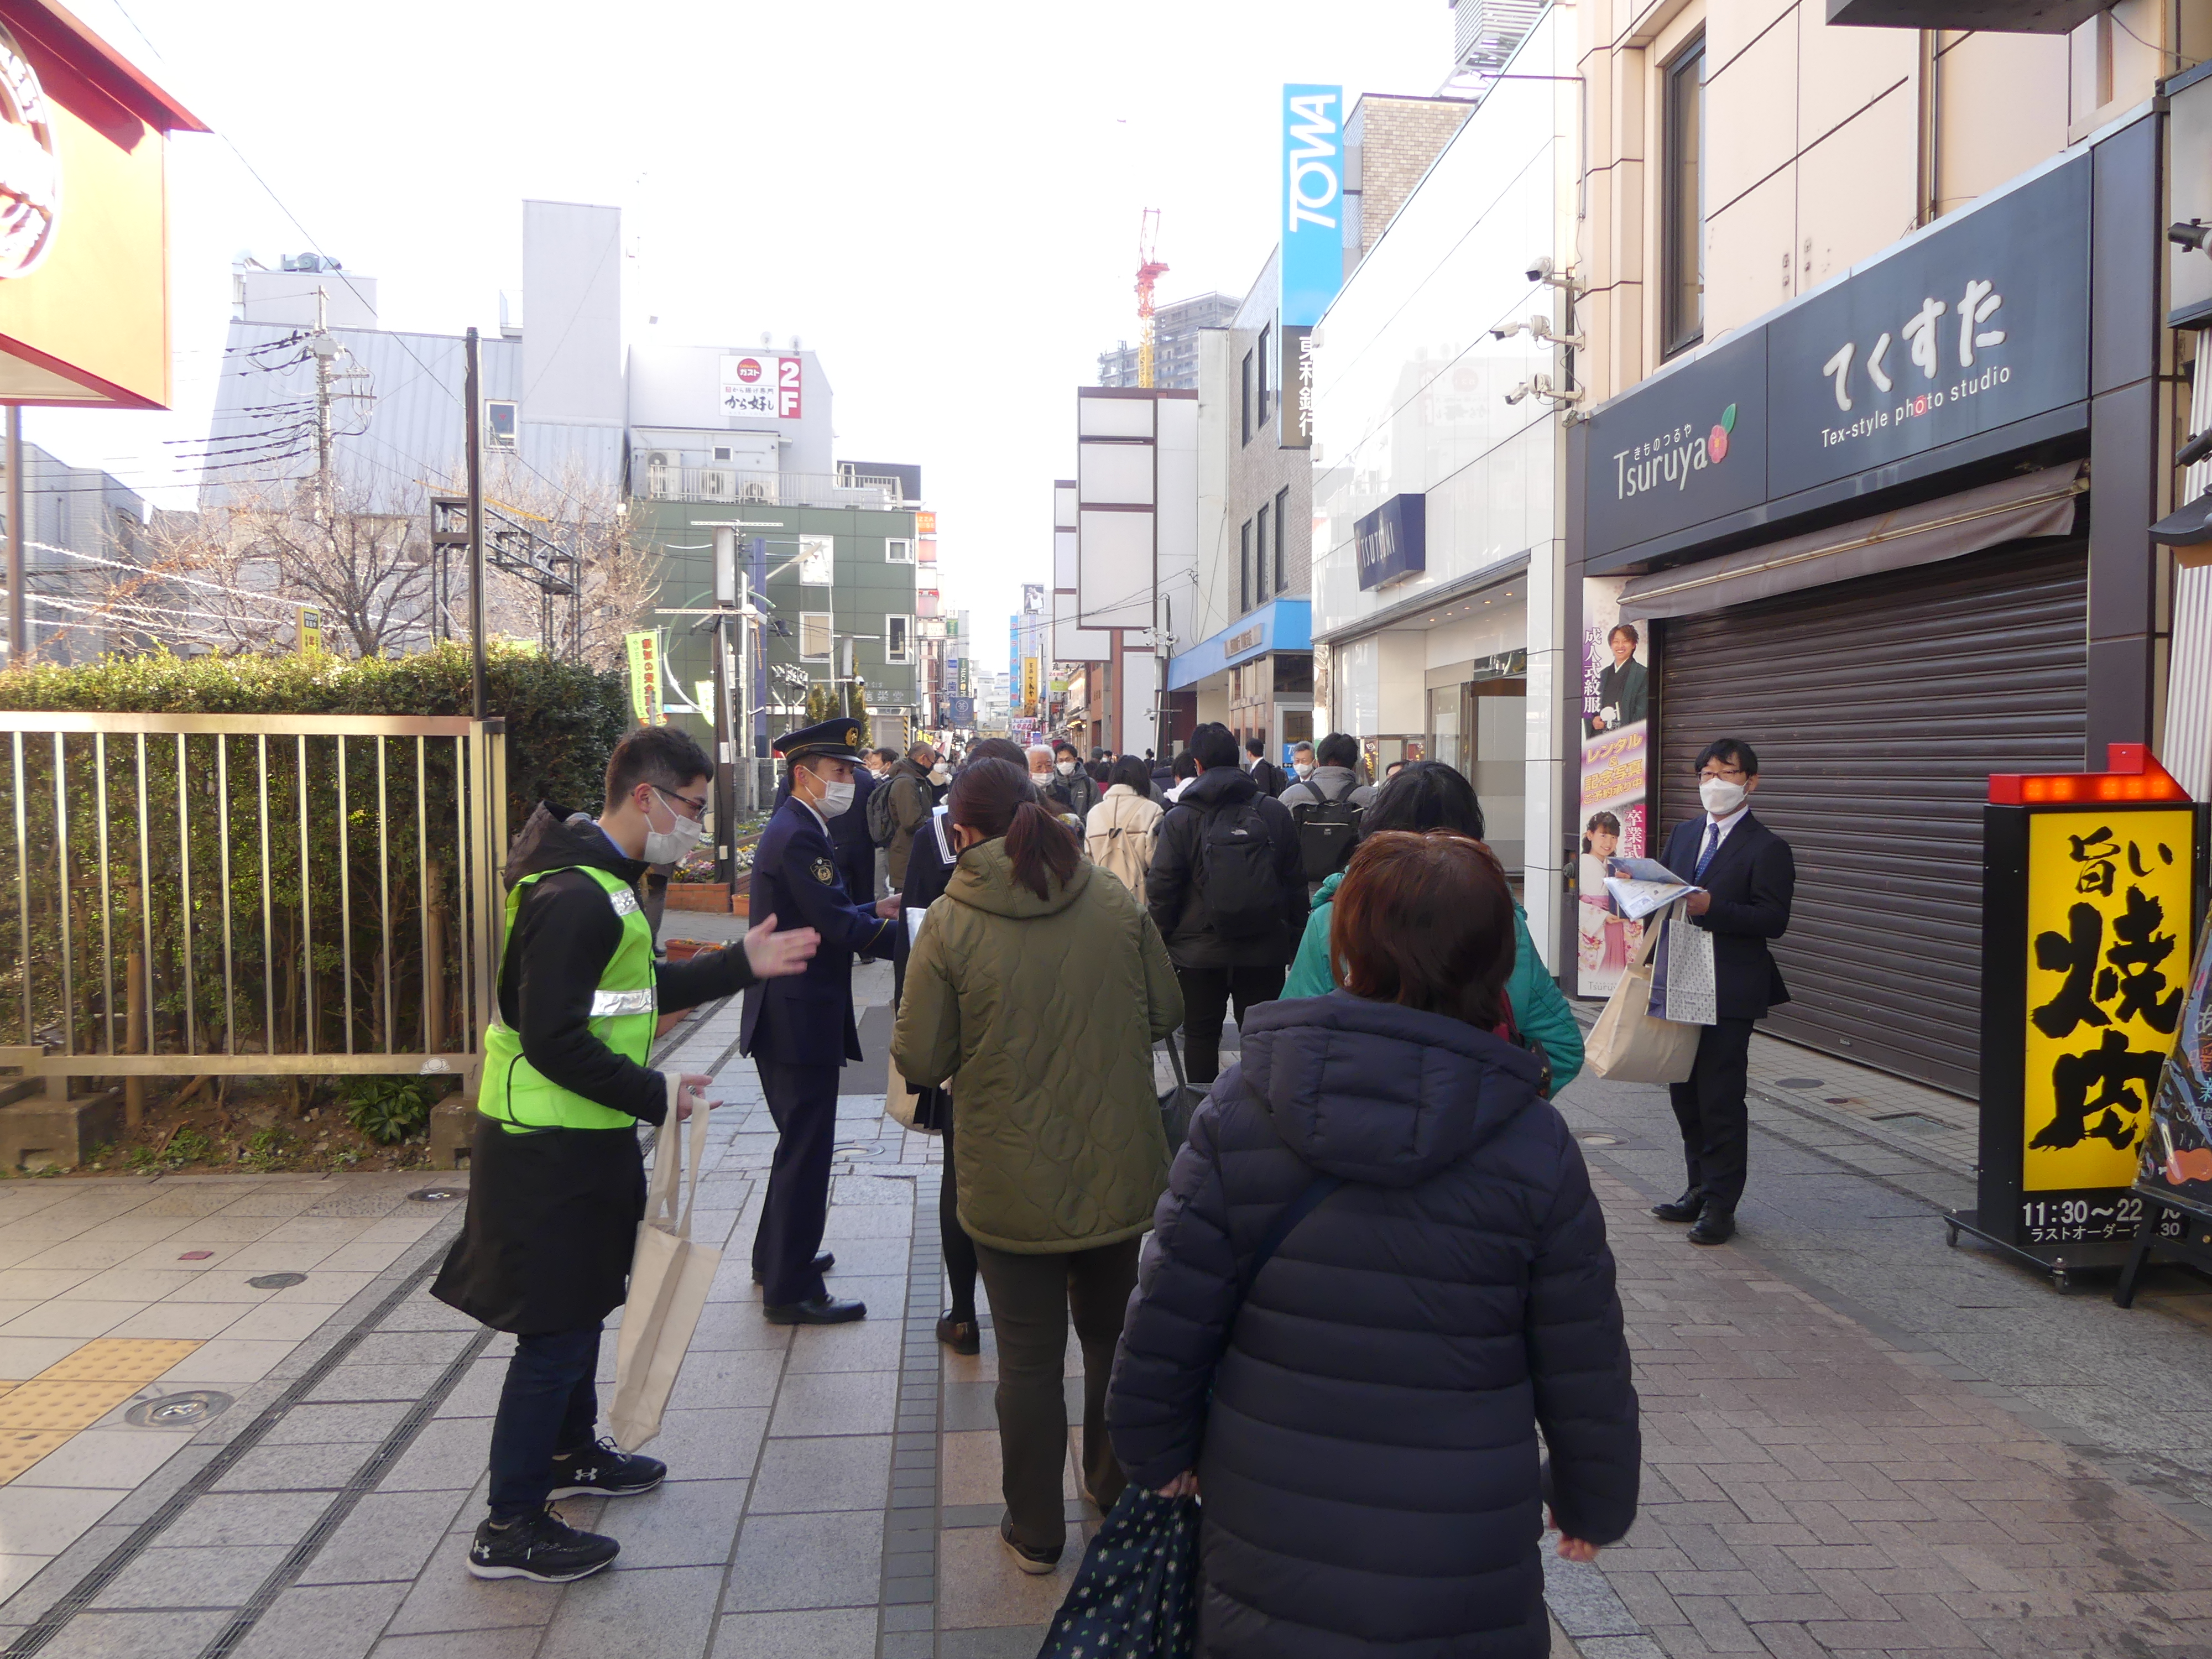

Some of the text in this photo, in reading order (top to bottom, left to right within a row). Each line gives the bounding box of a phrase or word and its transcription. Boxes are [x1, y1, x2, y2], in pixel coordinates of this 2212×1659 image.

[1289, 94, 1338, 232] TOWA
[1823, 280, 2006, 411] てくすた
[724, 395, 774, 412] から好し
[1822, 366, 2011, 448] Tex-style photo studio
[1613, 436, 1708, 500] Tsuruya
[1634, 424, 1692, 461] きものつるや
[1584, 627, 1602, 714] 成人式紋服
[1584, 759, 1642, 791] 記念写真
[1586, 733, 1643, 764] レンタル
[1609, 755, 1619, 767] &
[1583, 777, 1644, 805] ご予約承り中
[2069, 827, 2173, 896] 旨い
[2029, 885, 2185, 1157] 焼肉
